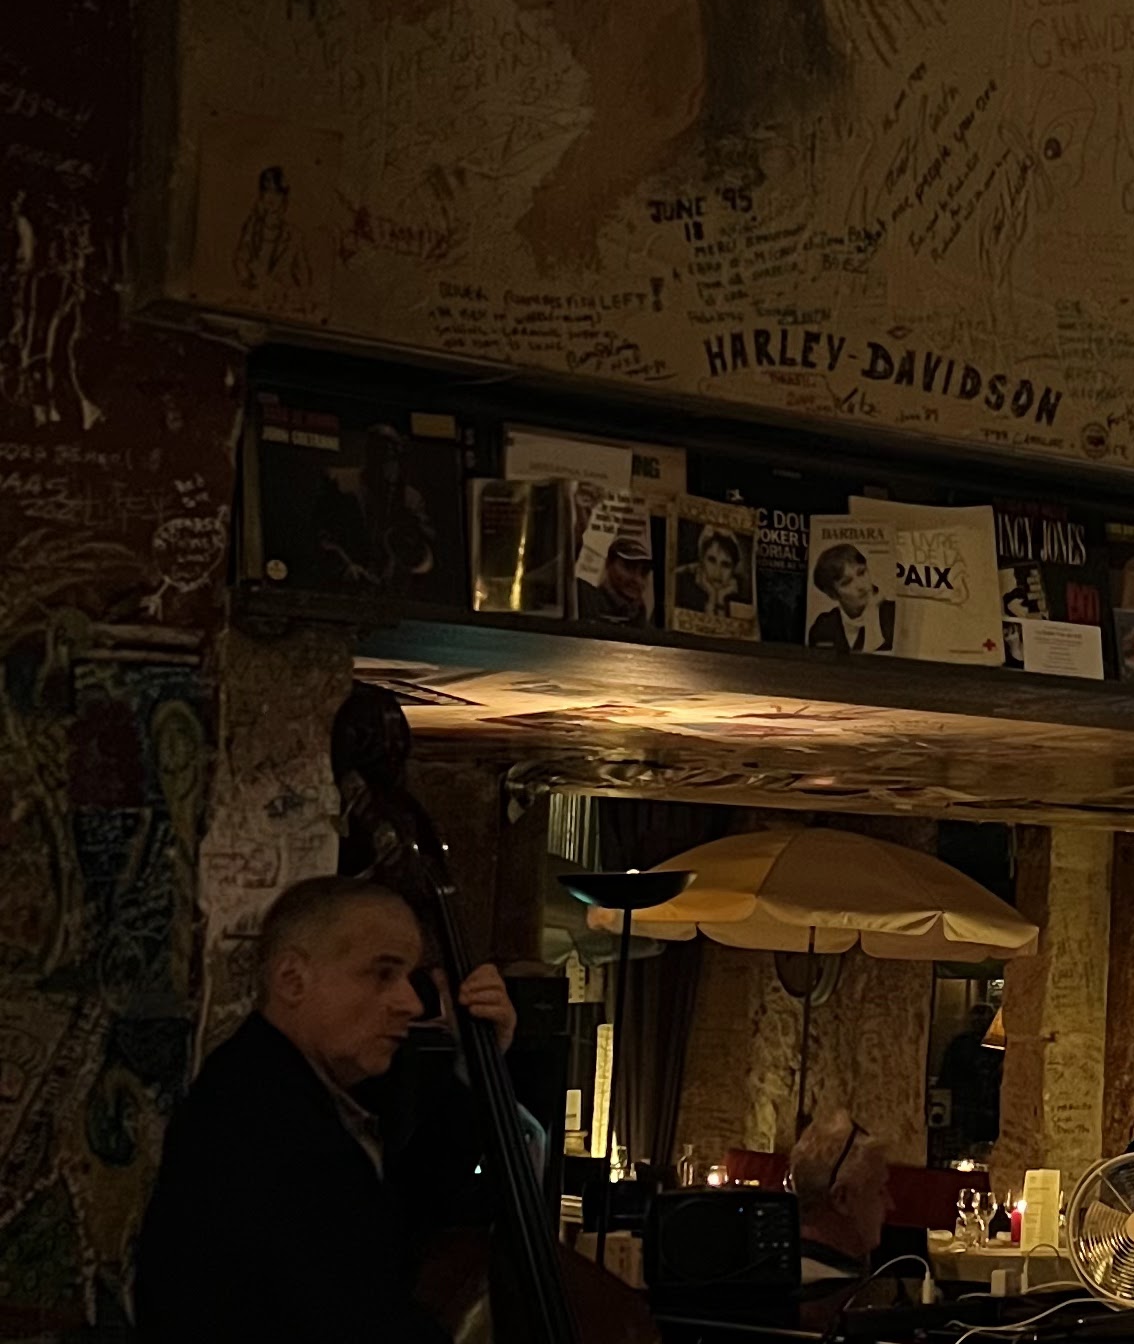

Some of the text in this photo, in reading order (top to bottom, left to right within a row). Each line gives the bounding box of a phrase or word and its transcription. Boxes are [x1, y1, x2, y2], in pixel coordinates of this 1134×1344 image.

[647, 195, 708, 224] JUNE
[703, 328, 1063, 427] HARLEY-DAVIDSON
[759, 528, 800, 546] OKER
[821, 527, 885, 541] BARBARA
[997, 511, 1088, 567] INCY JONES
[759, 543, 801, 562] ORIAL
